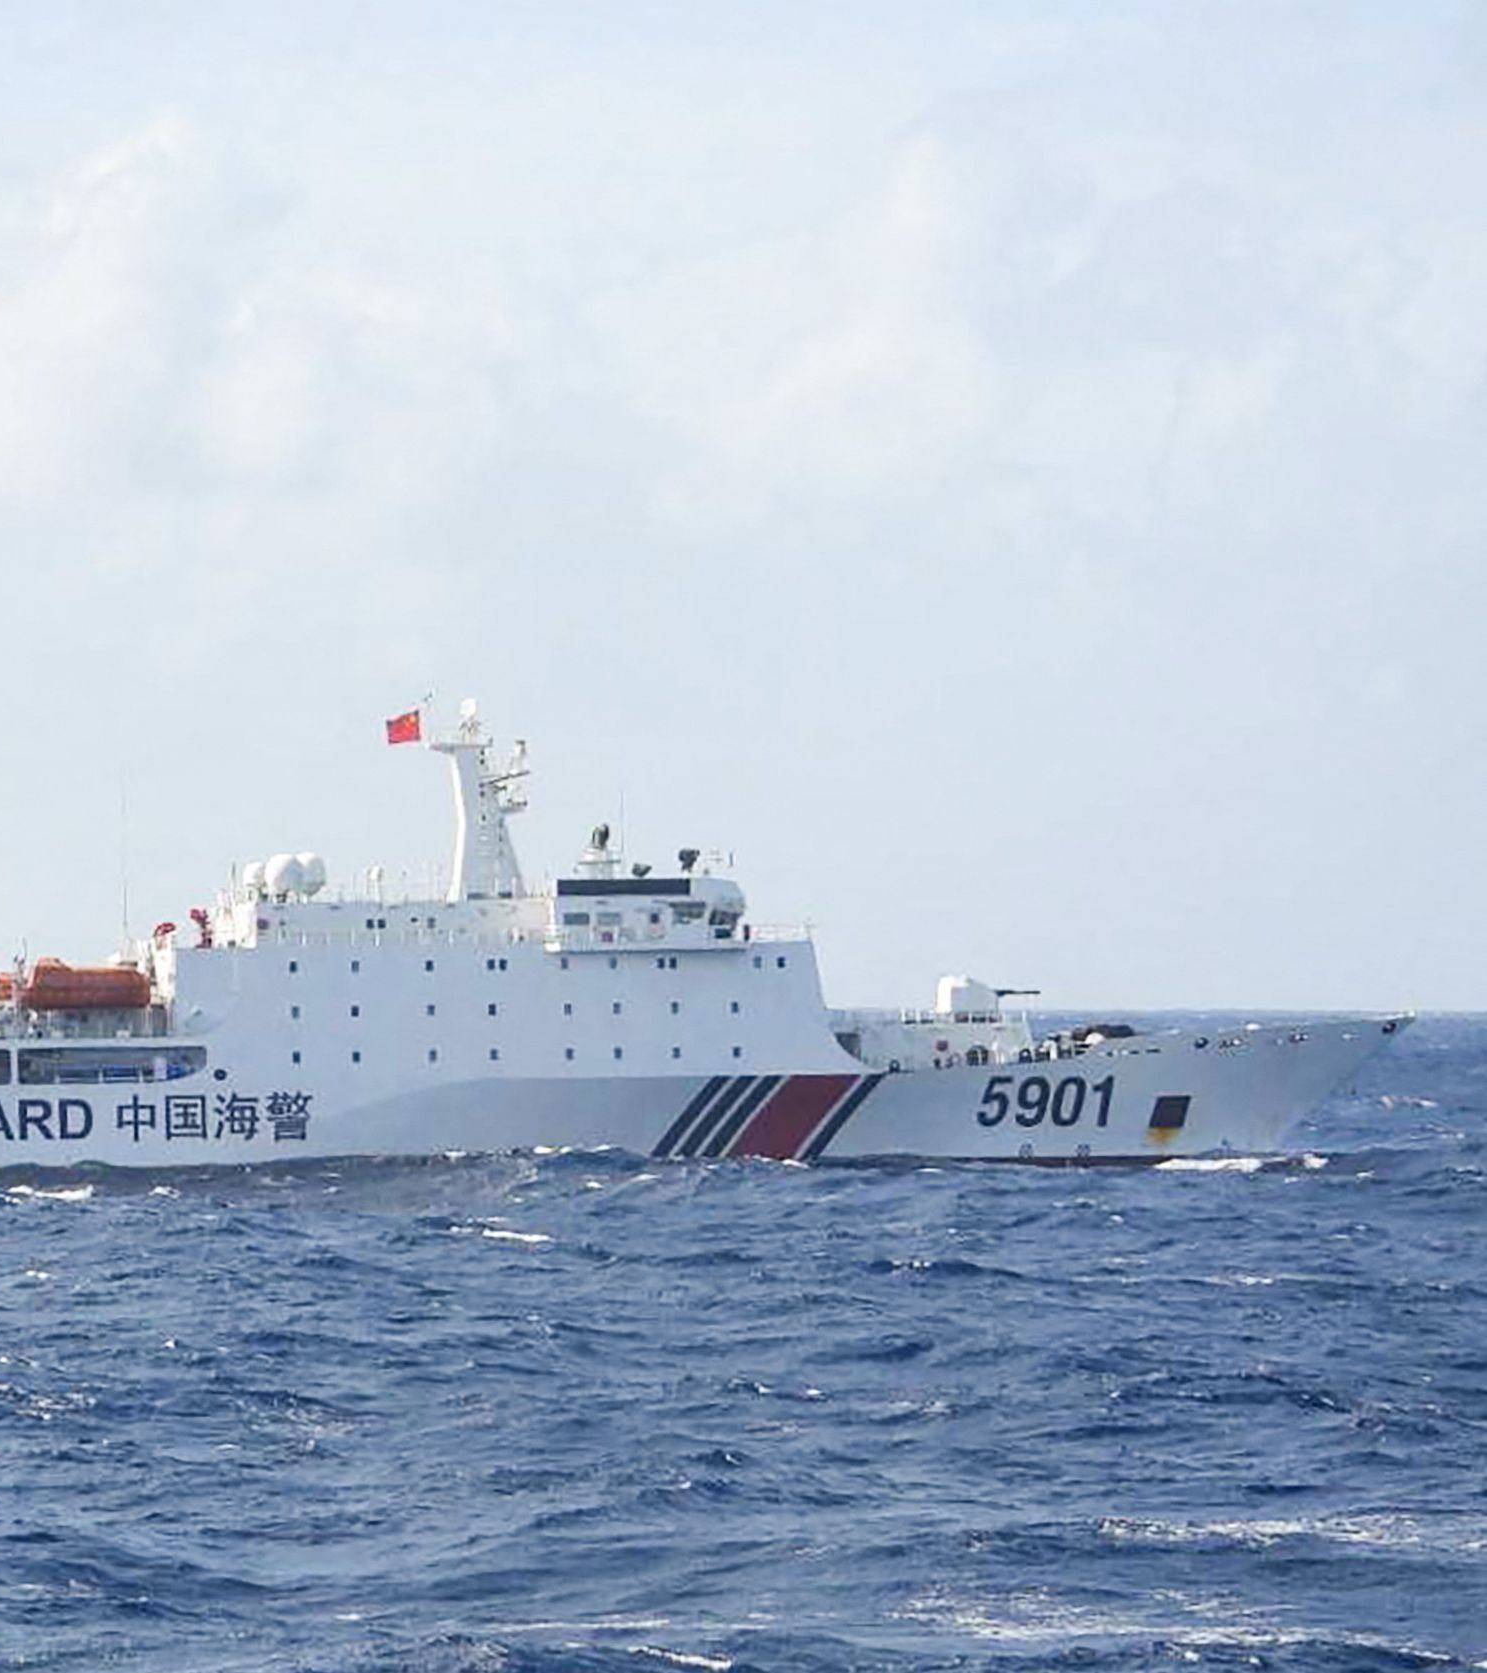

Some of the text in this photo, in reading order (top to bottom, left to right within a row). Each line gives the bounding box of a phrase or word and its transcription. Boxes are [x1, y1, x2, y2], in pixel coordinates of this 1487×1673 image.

[116, 1092, 313, 1143] 中国海警
[977, 1074, 1115, 1128] 5901
